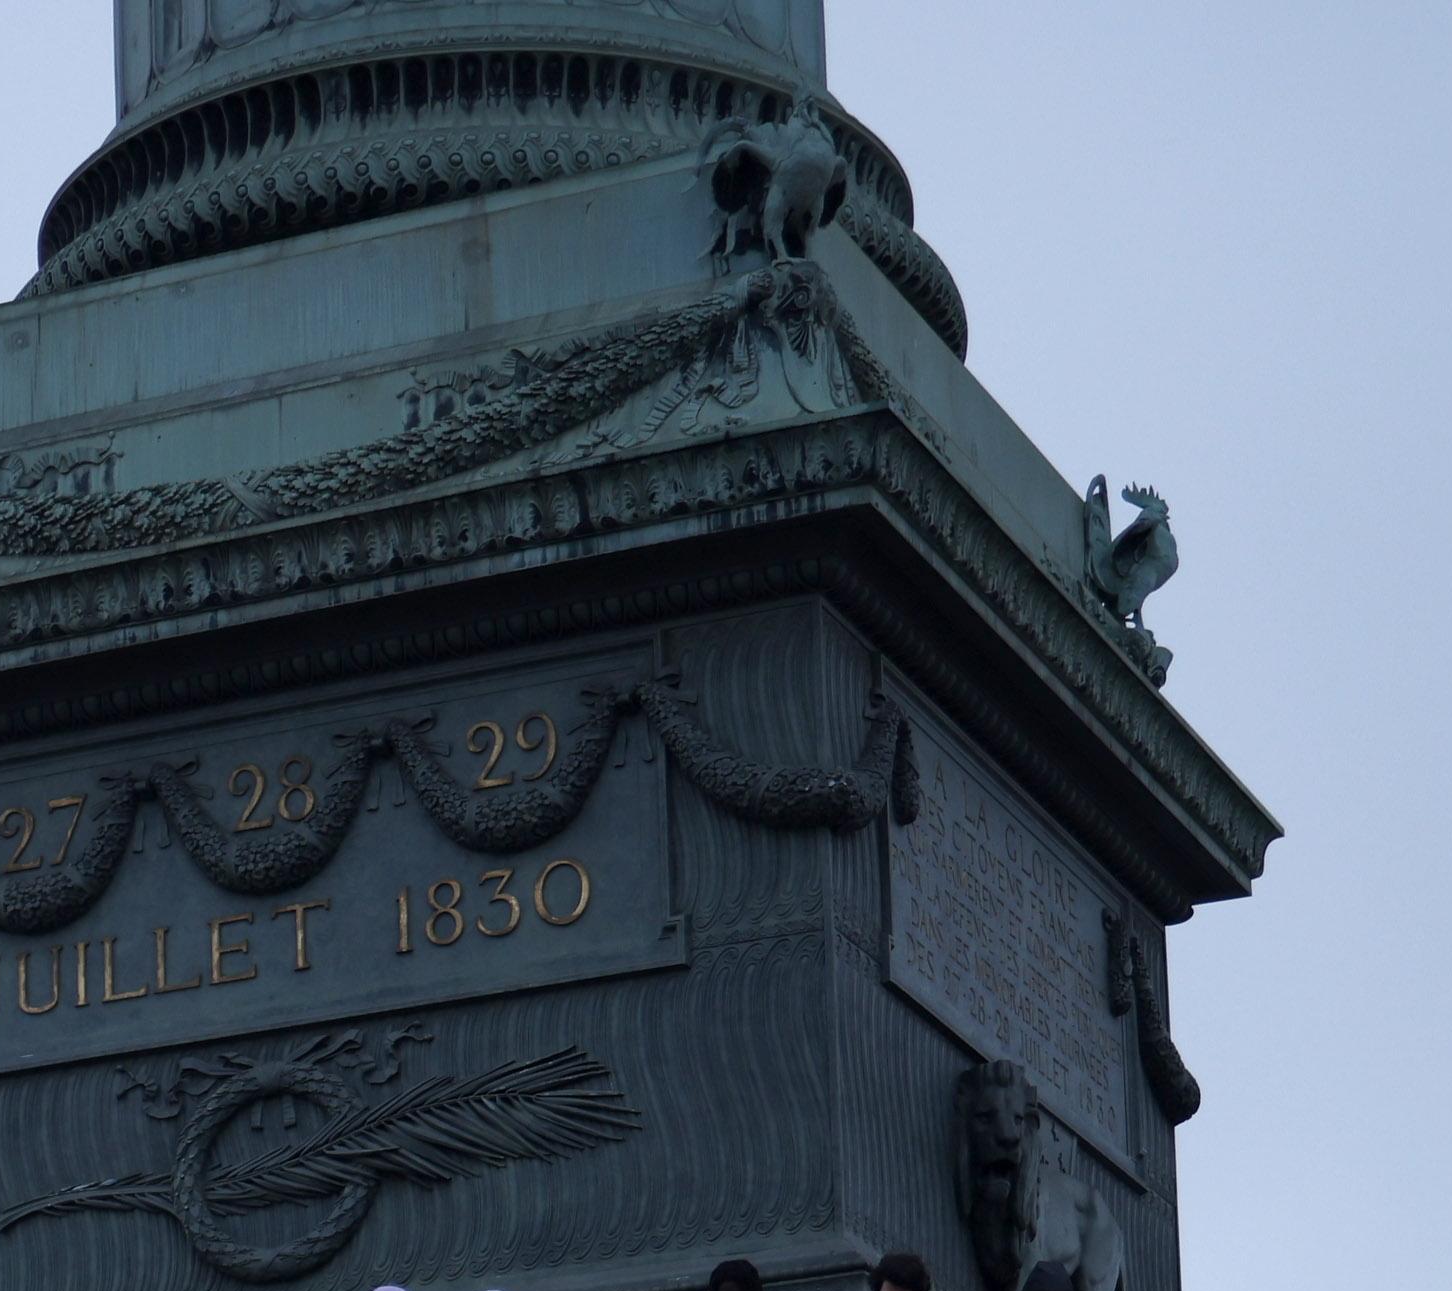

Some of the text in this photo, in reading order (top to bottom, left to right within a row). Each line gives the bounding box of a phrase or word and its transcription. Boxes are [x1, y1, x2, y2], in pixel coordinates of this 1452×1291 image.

[227, 756, 317, 833] 28
[464, 711, 558, 792] 29
[395, 858, 591, 954] 1830
[963, 780, 990, 840] LA
[1006, 824, 1078, 920] GLOIRE
